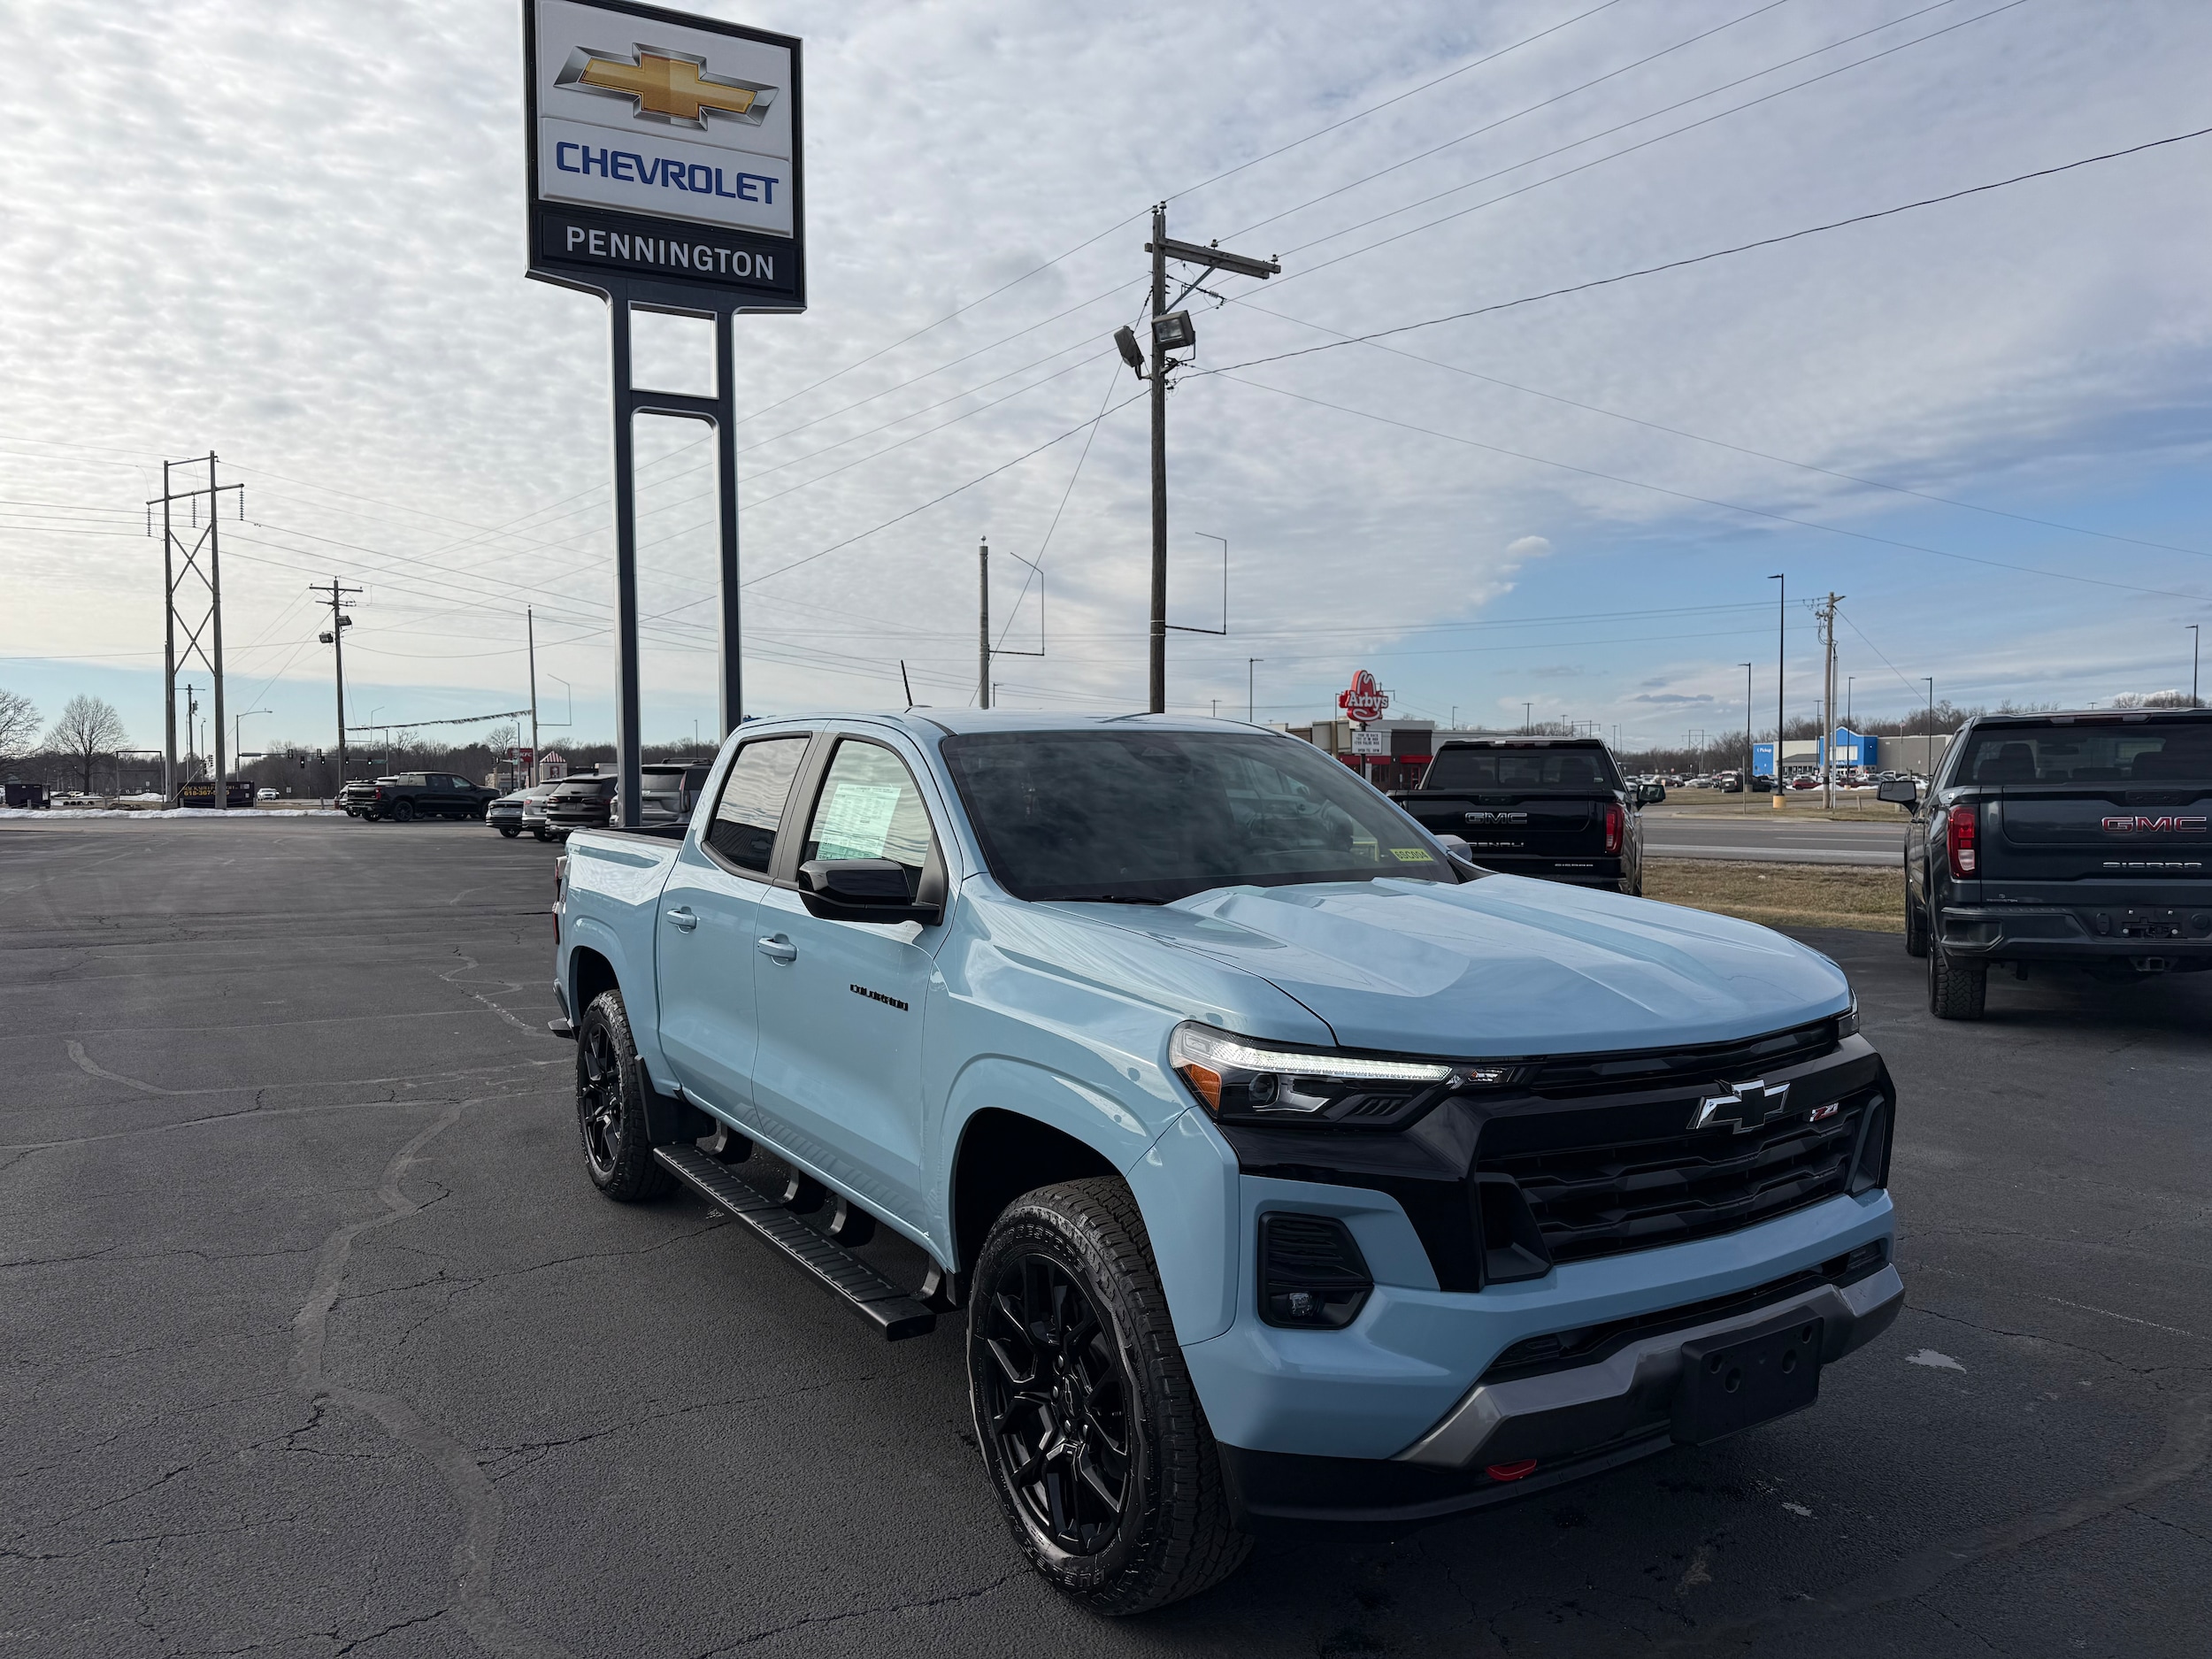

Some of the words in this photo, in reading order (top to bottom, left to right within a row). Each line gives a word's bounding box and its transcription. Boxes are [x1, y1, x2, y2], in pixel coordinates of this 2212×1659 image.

[556, 141, 779, 204] CHEVROLET
[566, 225, 774, 280] PENNINGTON
[1348, 691, 1388, 711] Arby's
[1465, 812, 1527, 824] GMC
[2101, 816, 2207, 833] GMC
[850, 983, 909, 1012] COLORADO
